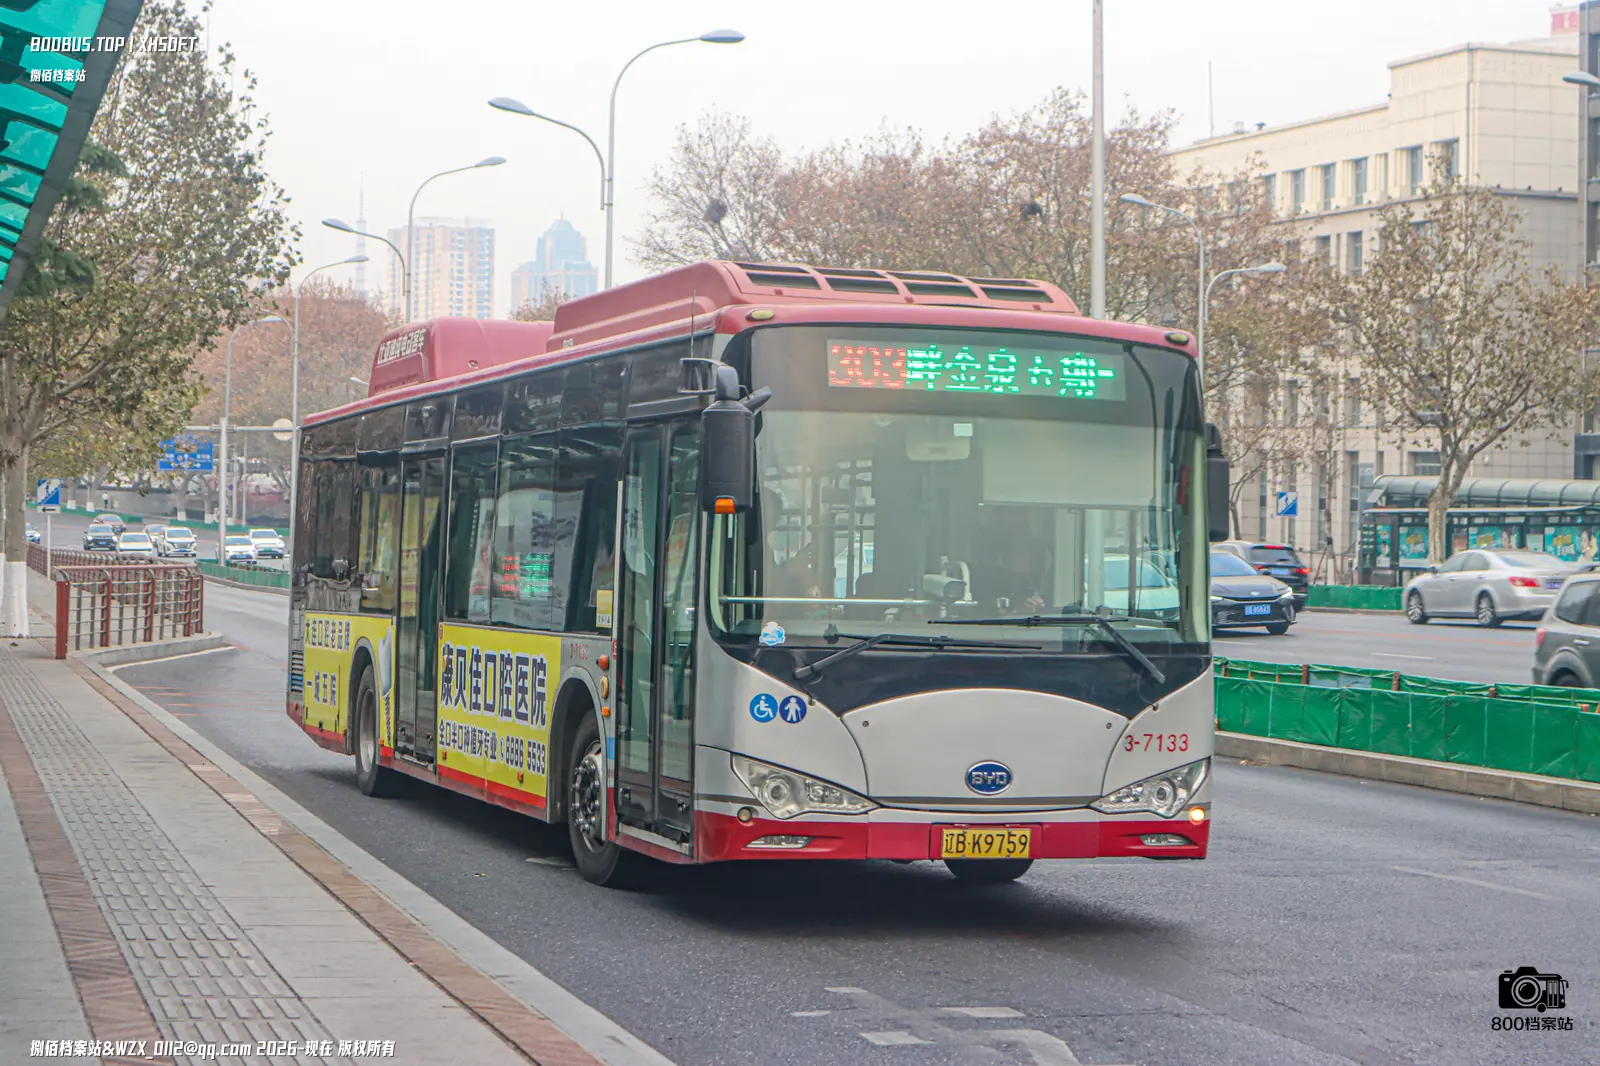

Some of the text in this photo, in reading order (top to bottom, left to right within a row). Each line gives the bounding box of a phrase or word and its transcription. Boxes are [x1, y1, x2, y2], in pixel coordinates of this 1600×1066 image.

[440, 642, 547, 727] 康贝佳口腔医院
[438, 718, 498, 761] 全口半口种植牙专业
[527, 740, 546, 775] 5533
[1123, 733, 1190, 753] 3-7133
[971, 771, 1008, 786] BYD
